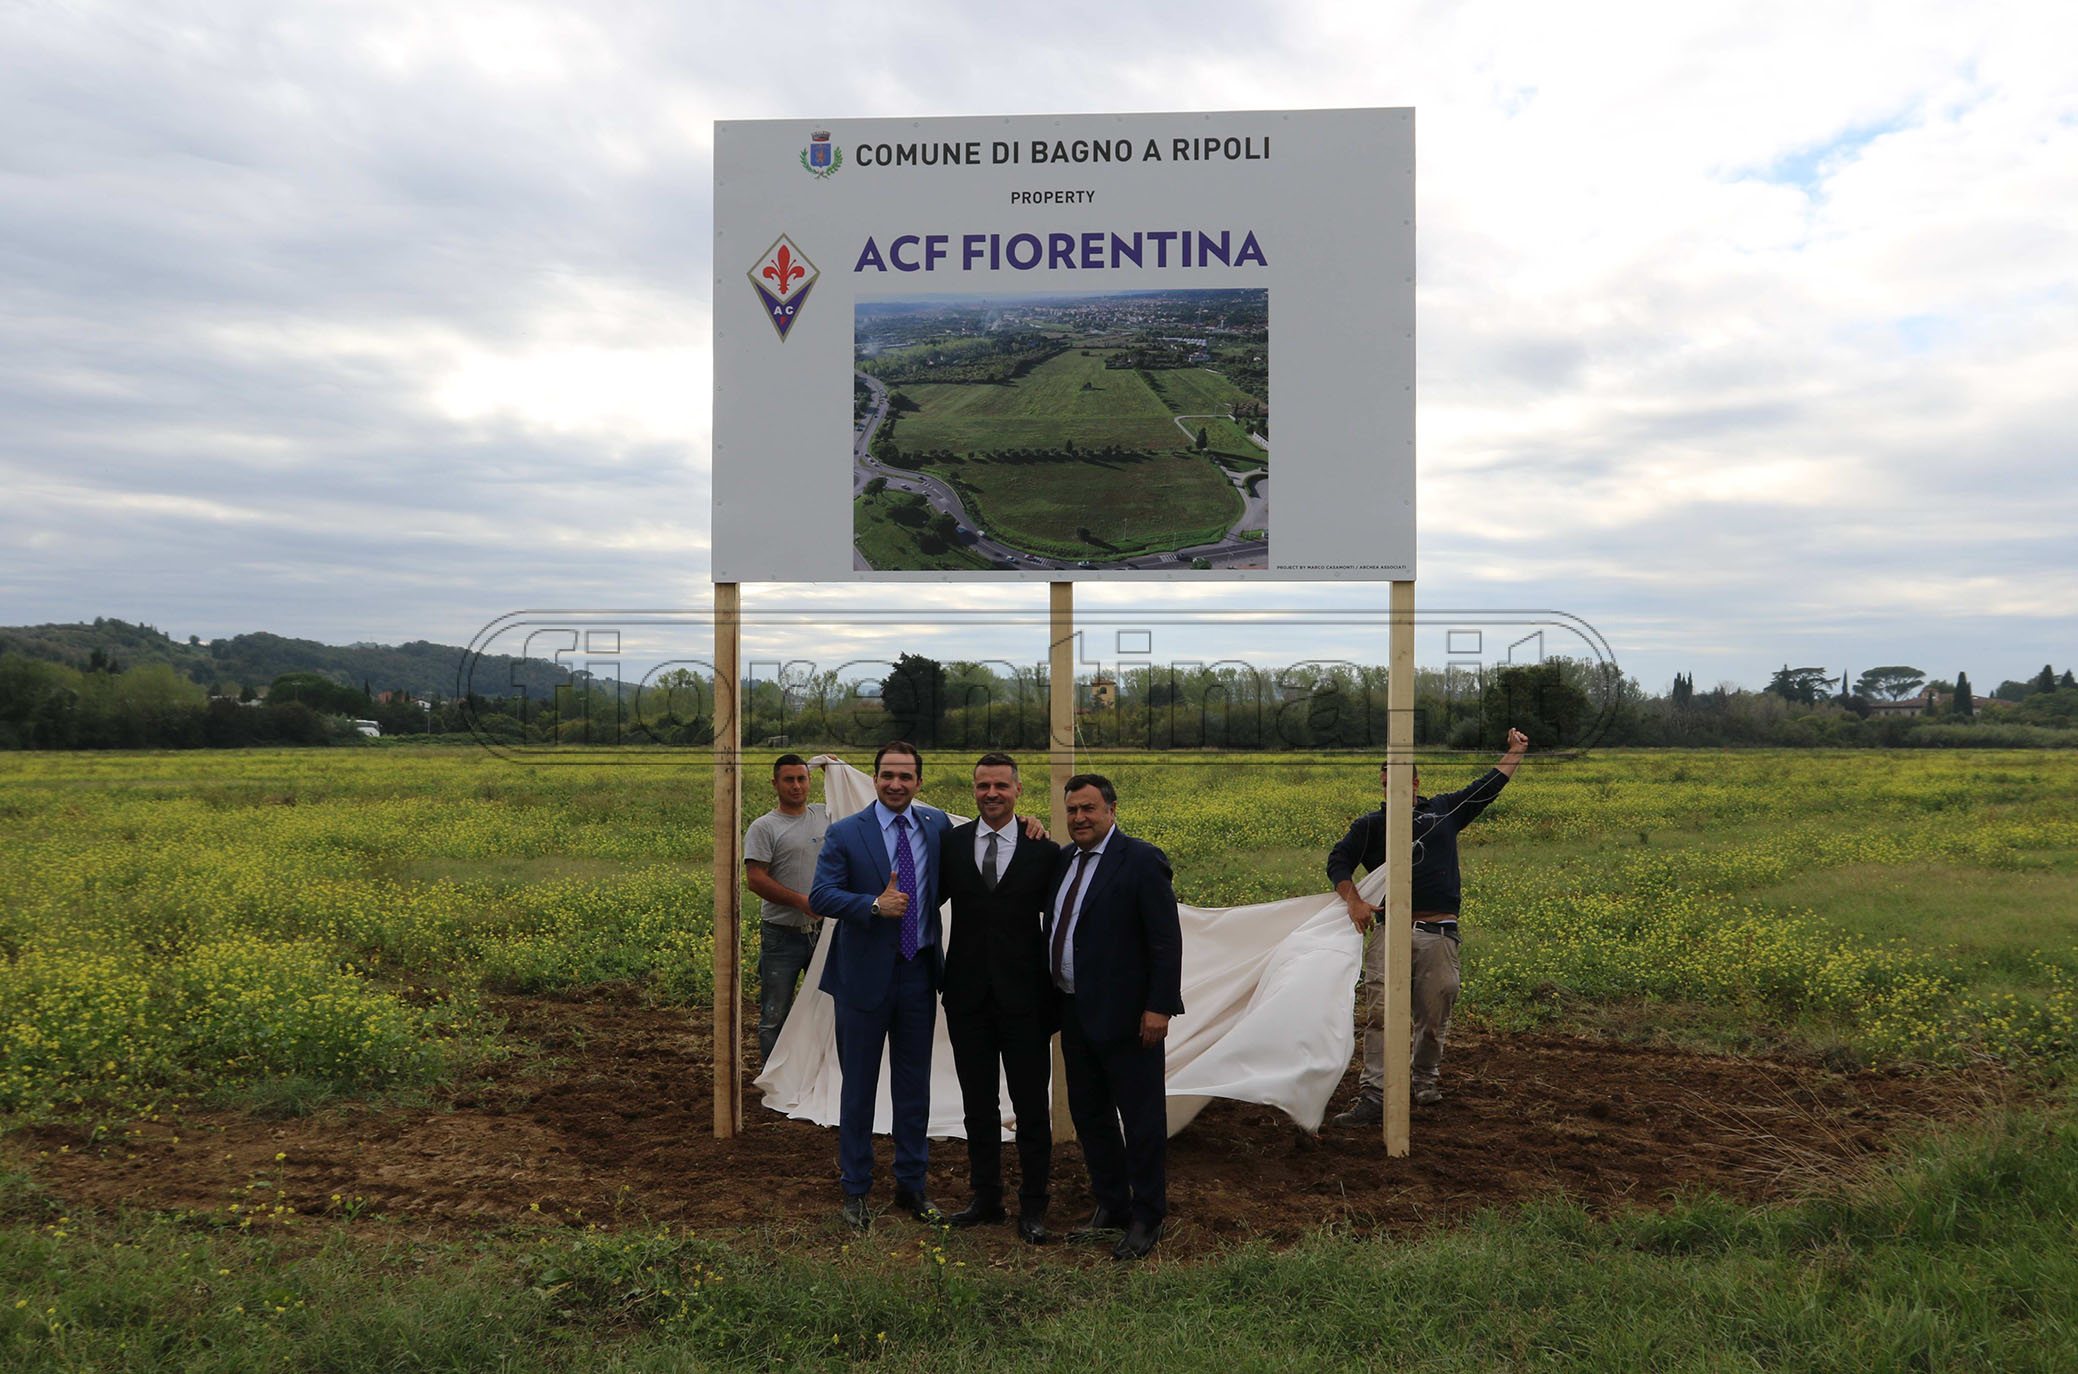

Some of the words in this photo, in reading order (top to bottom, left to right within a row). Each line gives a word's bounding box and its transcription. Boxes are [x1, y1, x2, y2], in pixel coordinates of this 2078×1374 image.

[855, 141, 981, 167] COMUNE
[992, 141, 1019, 165] DI
[1031, 139, 1133, 164] BAGNO
[1142, 138, 1162, 162] A
[1173, 136, 1270, 162] RIPOLI
[1011, 190, 1096, 205] PROPERTY
[853, 234, 949, 273] ACF
[962, 229, 1269, 271] FIORENTINA
